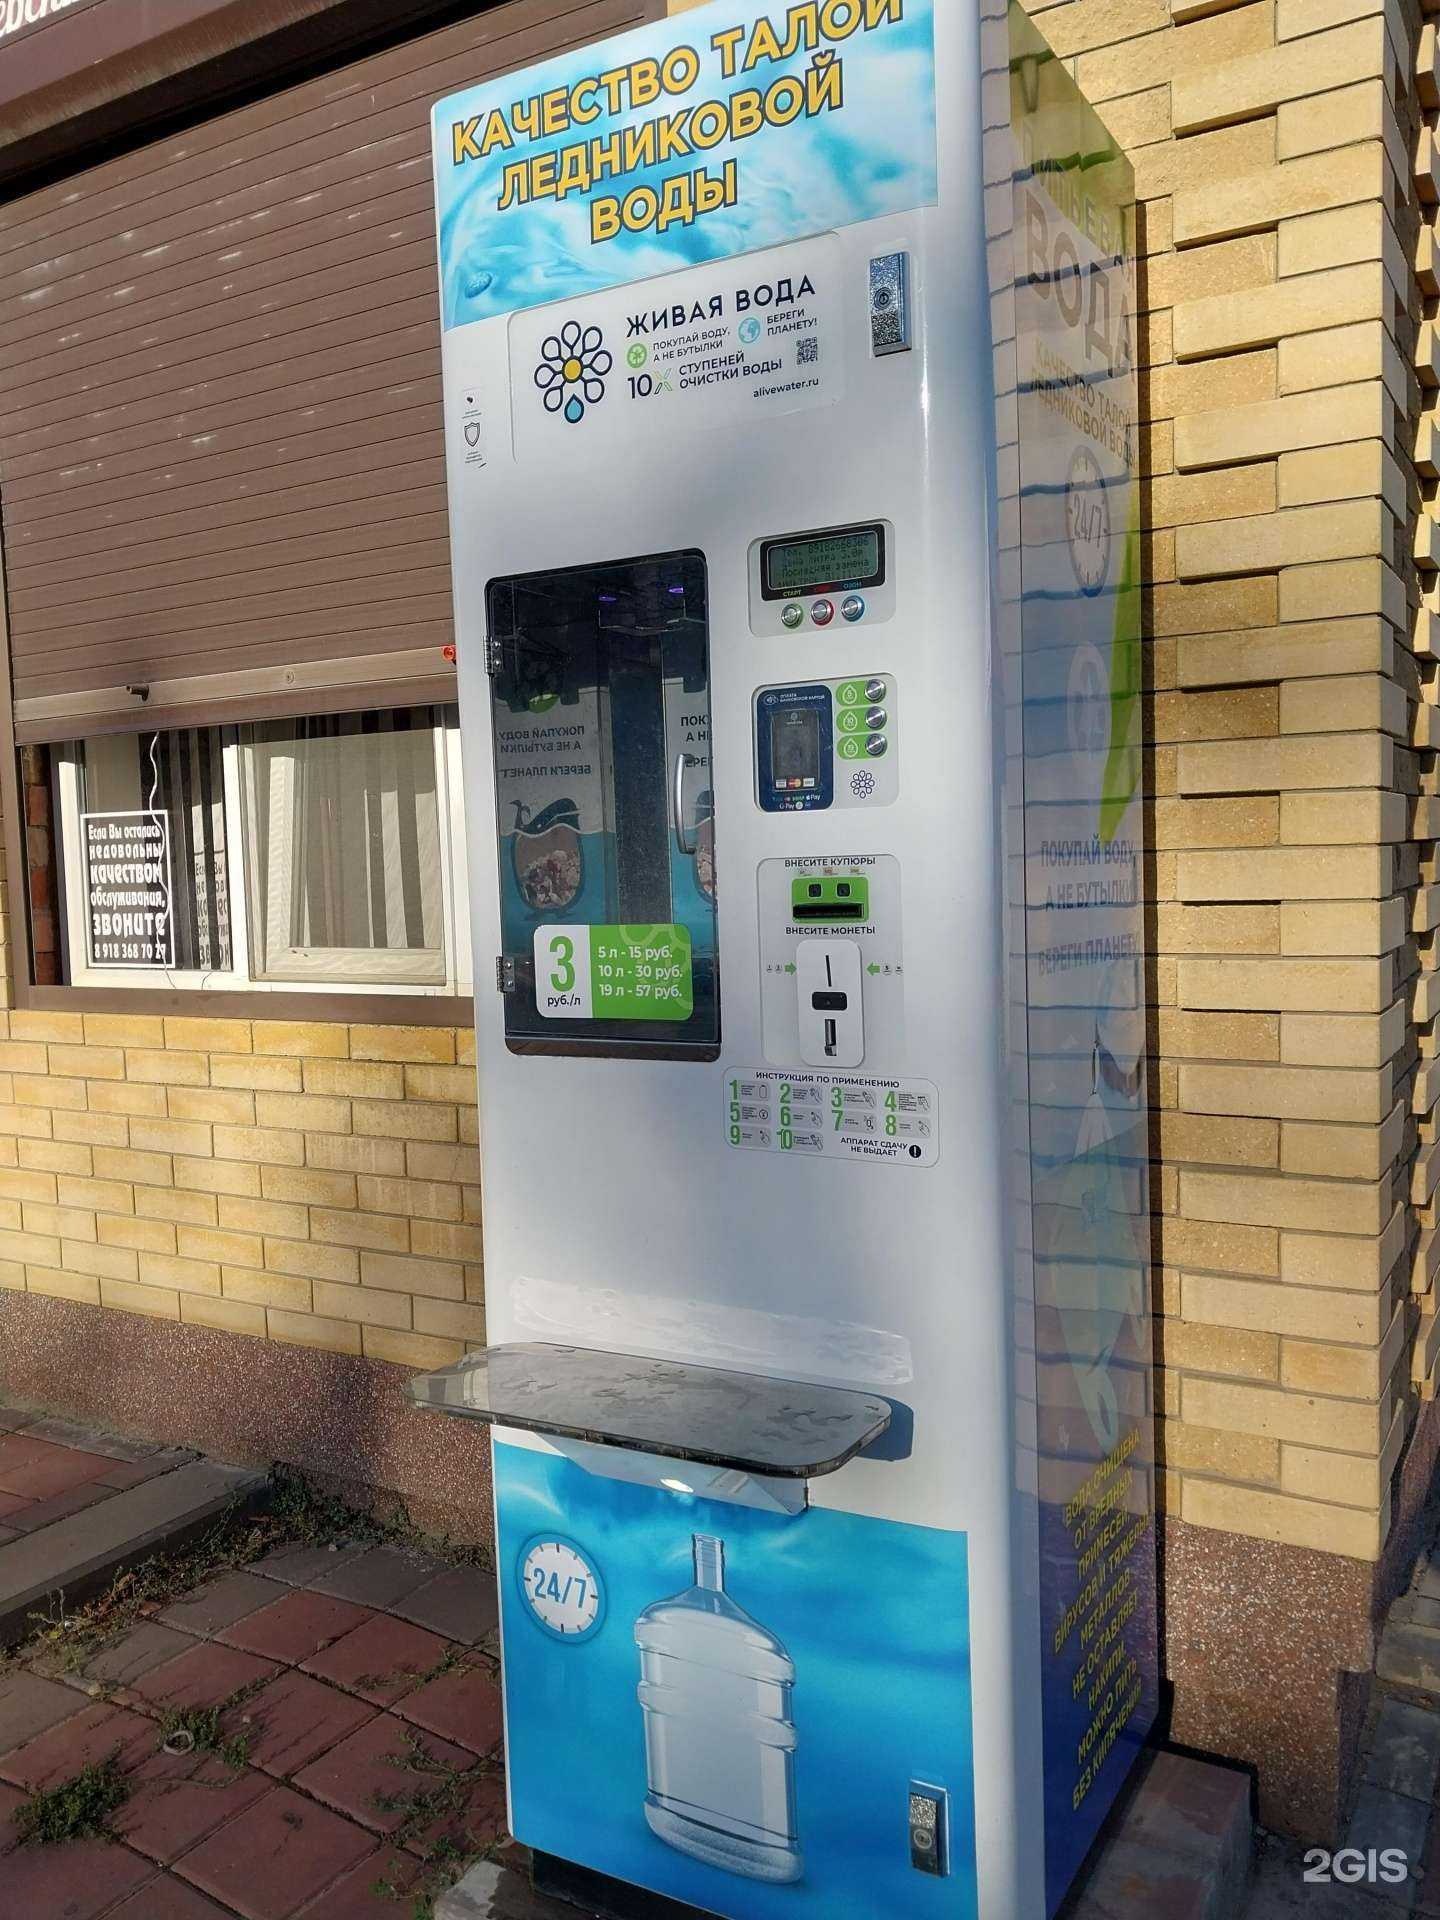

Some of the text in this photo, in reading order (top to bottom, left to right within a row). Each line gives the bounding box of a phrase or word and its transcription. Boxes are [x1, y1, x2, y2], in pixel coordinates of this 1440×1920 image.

[453, 0, 903, 165] КАЧЕСТВО ТАЛОЙ
[498, 48, 842, 210] ЛЕДНИКОВОЙ
[591, 158, 738, 244] ВОДЫ
[1025, 188, 1133, 378] ВОДА
[626, 274, 816, 338] ЖИВАЯ ВОДА
[767, 309, 805, 324] БЕРЕГИ
[767, 318, 818, 336] ПЛАНЕТУ!
[653, 326, 730, 351] ПОКУПАЙ ВОДУ,
[653, 340, 723, 362] А НЕ БУТЫЛКИ
[679, 350, 745, 376] СТУПЕНЕЙ
[679, 358, 782, 389] ОЧИСТКИ ВОДЫ
[752, 378, 819, 398] alivewater.ru
[1072, 492, 1101, 549] 24/7
[680, 715, 708, 726] ПОК
[686, 731, 694, 742] А
[88, 823, 161, 840] Если Вы остались
[89, 843, 162, 860] недовольны
[1041, 833, 1101, 867] ПОКУПАЙ
[785, 857, 876, 867] ВНЕСИТЕ КУПЮРЫ
[90, 863, 163, 885] качеством
[1057, 883, 1073, 908] НЕ
[1077, 878, 1137, 907] БУТЫЛКИ
[785, 926, 875, 935] ВНЕСИТЕ МОНЕТЫ
[94, 944, 100, 958] 8
[102, 943, 119, 958] 918
[121, 943, 139, 958] 368
[141, 943, 153, 958] 70
[598, 947, 605, 959] 5
[608, 949, 617, 958] л
[629, 947, 641, 958] 15
[645, 946, 673, 961] руб.
[1040, 943, 1084, 976] БЕРЕГИ
[549, 935, 576, 992] 3
[600, 965, 612, 977] 10
[615, 967, 624, 977] л
[635, 965, 651, 977] 30
[655, 964, 683, 980] руб.
[547, 993, 581, 1007] руб./л
[600, 984, 613, 996] 19
[615, 986, 624, 996] л
[635, 984, 651, 996] 57
[654, 983, 682, 999] руб.
[729, 1080, 738, 1100] 1
[756, 1071, 900, 1088] ИНСТРУКЦИЯ ПО ПРИМЕНЕНИЮ
[780, 1083, 791, 1104] 2
[831, 1087, 842, 1107] 3
[884, 1091, 897, 1112] 4
[730, 1102, 740, 1122] 5
[781, 1106, 791, 1126] 6
[831, 1110, 843, 1131] 7
[730, 1125, 740, 1145] 9
[885, 1114, 897, 1135] 8
[776, 1129, 792, 1149] 10
[840, 1137, 908, 1149] АППАРАТ СДАЧУ
[864, 1147, 898, 1156] ВЫДАЕТ
[1074, 1521, 1087, 1549] ОТ
[533, 1567, 587, 1608] 24/7
[1073, 1664, 1086, 1699] НЕ
[1078, 1692, 1114, 1765] МОЖНО
[1073, 1766, 1092, 1811] БЕЗ
